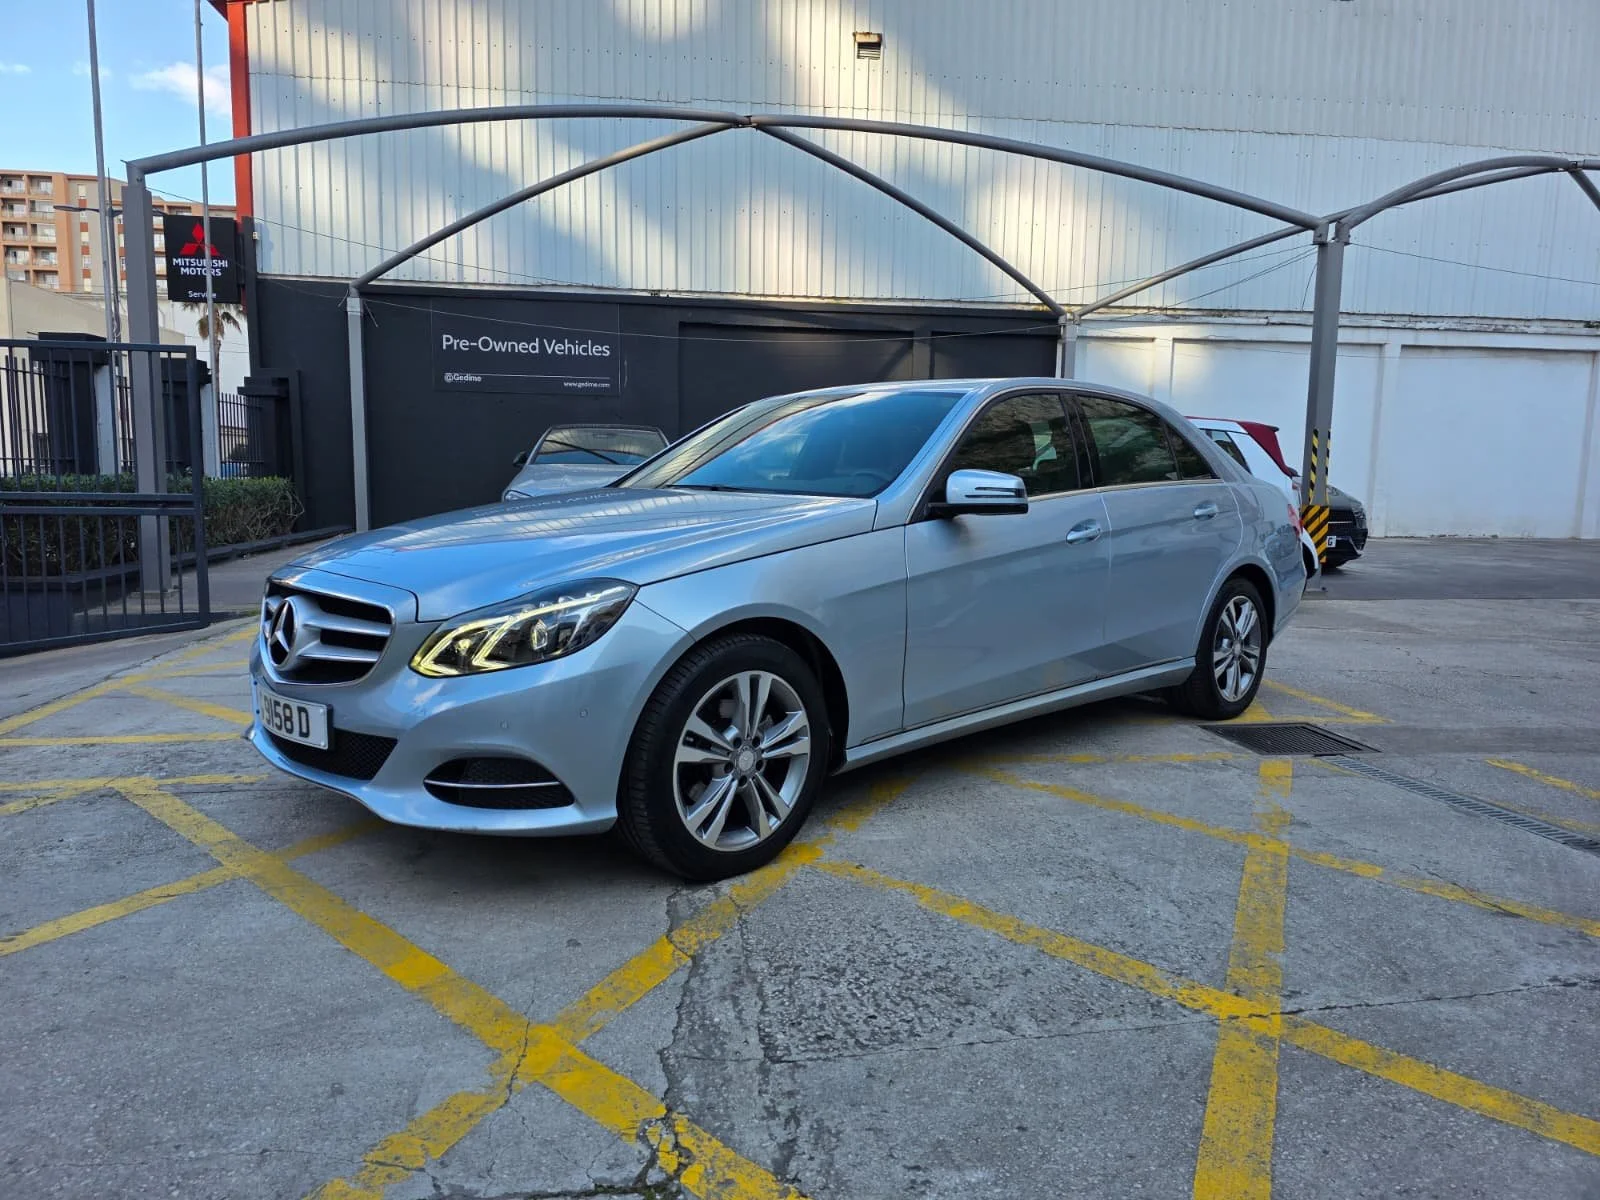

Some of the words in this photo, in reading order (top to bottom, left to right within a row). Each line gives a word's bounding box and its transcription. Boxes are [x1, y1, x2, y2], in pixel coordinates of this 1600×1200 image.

[172, 258, 228, 268] MITSUSHI
[188, 290, 216, 298] Servie
[442, 333, 540, 355] Pre-Owned
[543, 338, 611, 357] Vehicles
[297, 705, 310, 738] D
